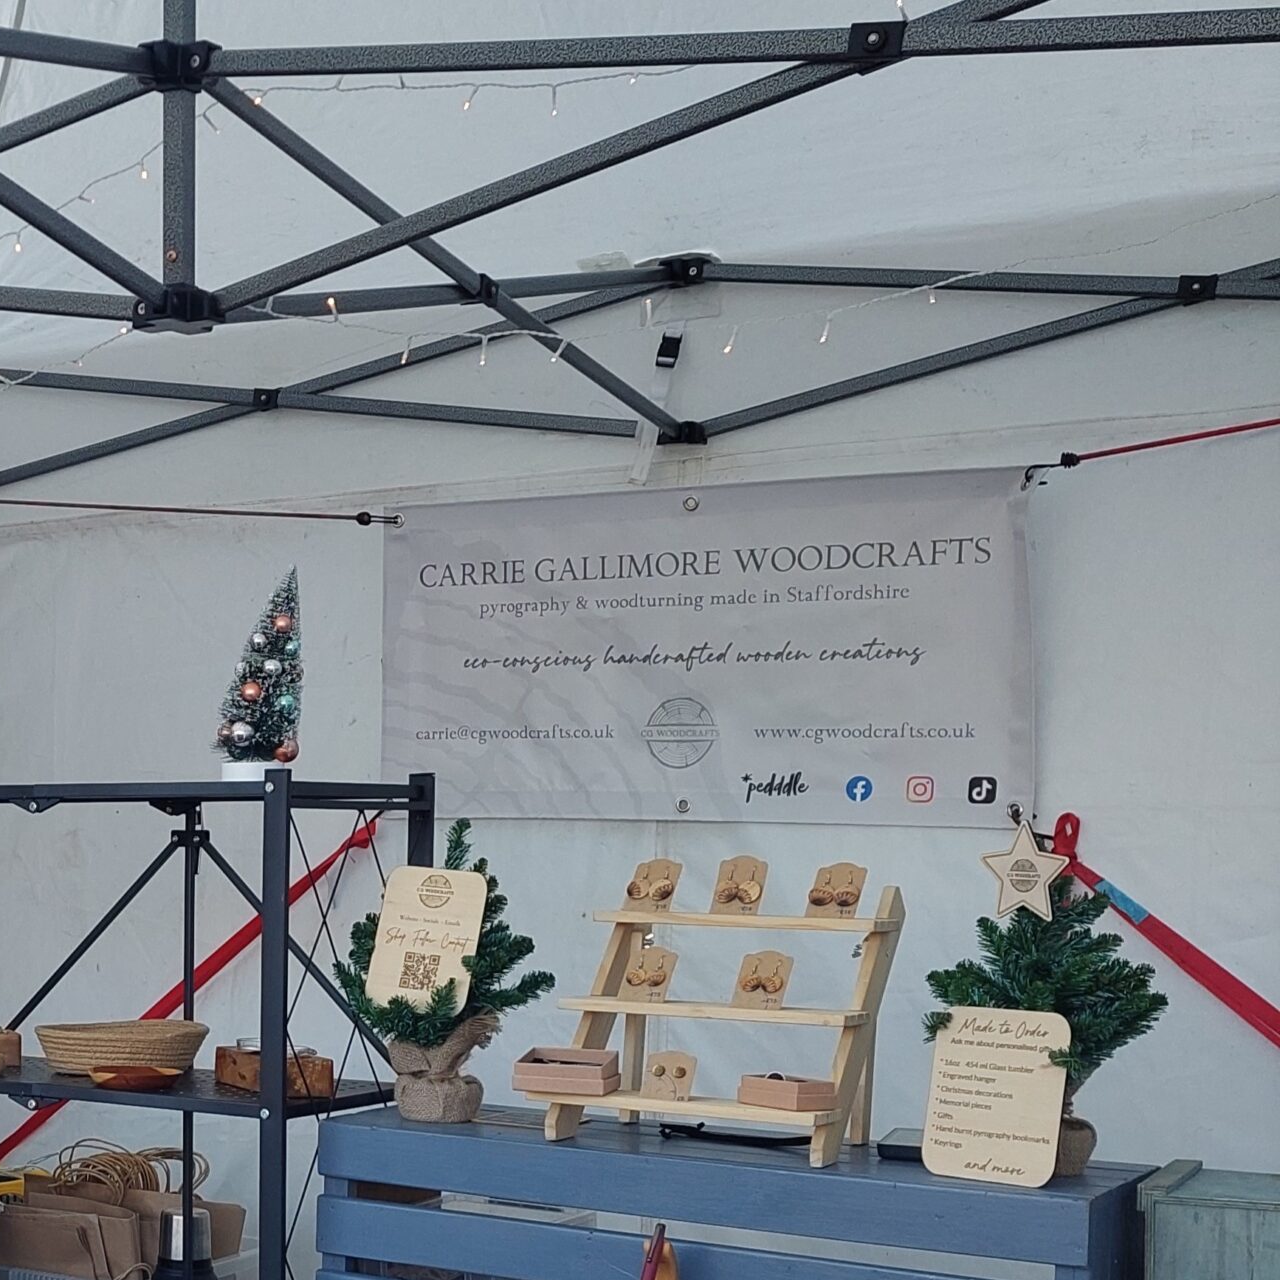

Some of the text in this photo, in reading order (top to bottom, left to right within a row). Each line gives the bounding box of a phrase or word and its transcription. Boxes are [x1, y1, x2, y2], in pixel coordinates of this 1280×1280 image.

[419, 536, 992, 588] CARRIE GALLIMORE WOODCRAFTS
[479, 583, 910, 619] pyrography & woodturning made in Staffordshire
[463, 637, 928, 674] eco-conscious handcrafted wooden creations
[415, 723, 615, 745] carrie@cgwoodcrafts.co.uk
[753, 722, 975, 744] www.cgwoodcrafts.co.uk
[958, 1017, 1050, 1040] Made to Order
[950, 1037, 963, 1046] Ask
[975, 1039, 995, 1048] about
[965, 1060, 979, 1069] 454
[989, 1062, 1007, 1072] Glass
[942, 1071, 997, 1084] Engraved hanger
[940, 1085, 1014, 1100] Christmas decorations
[939, 1098, 992, 1111] Memorial pieces
[937, 1112, 954, 1120] Gifts
[935, 1124, 1050, 1145] Hand burnt pyrography bookmarks
[933, 1138, 963, 1150] Keyrings
[964, 1158, 1026, 1176] and more
